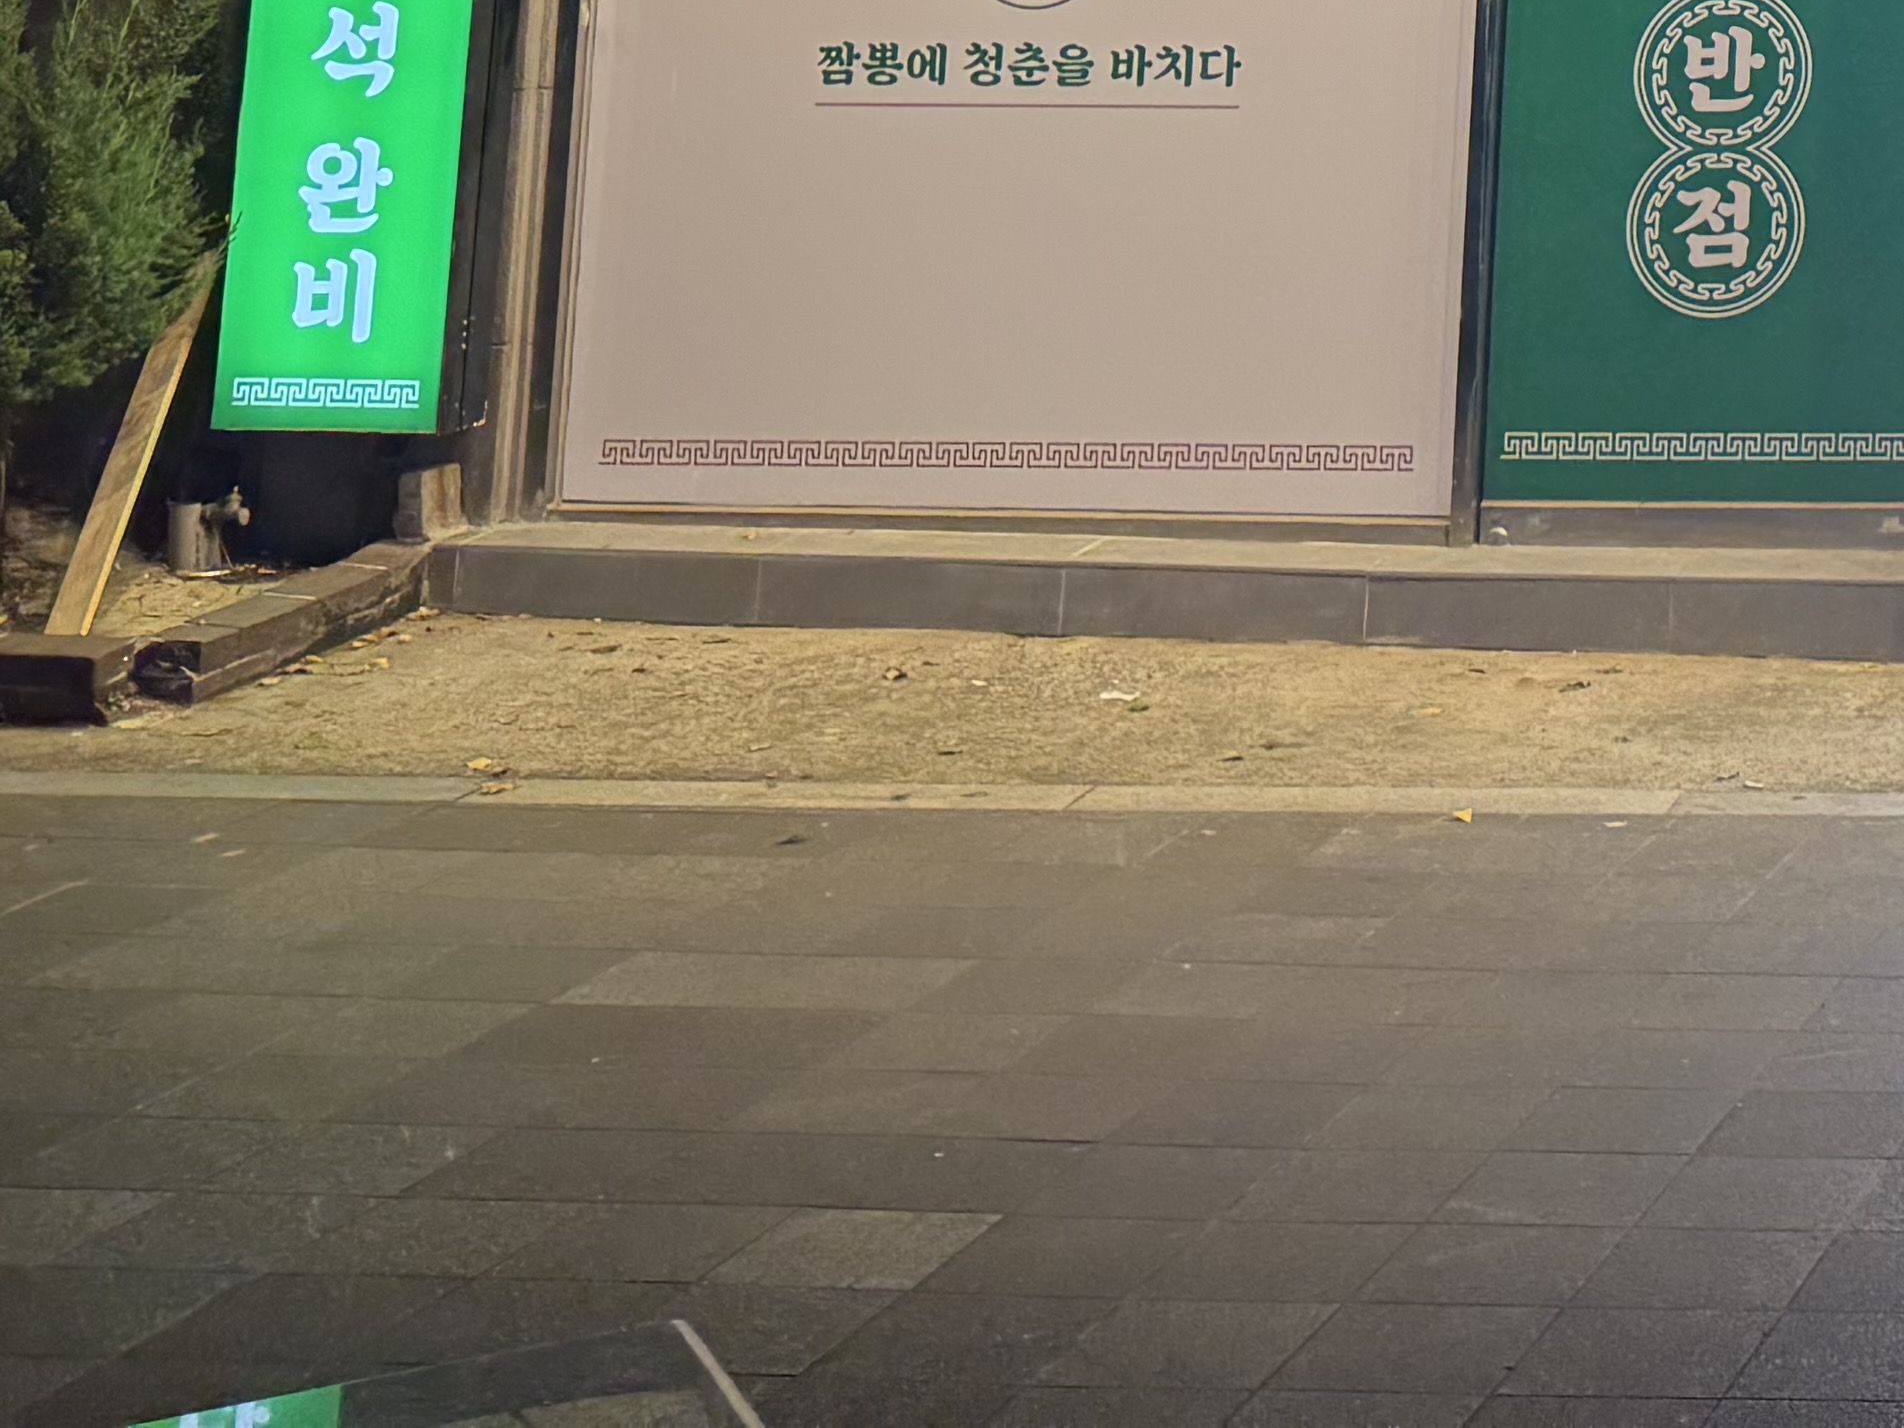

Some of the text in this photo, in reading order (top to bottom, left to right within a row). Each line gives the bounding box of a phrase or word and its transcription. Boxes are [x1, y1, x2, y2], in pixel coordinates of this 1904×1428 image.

[816, 40, 1243, 88] 짬뽕에 청춘을 바치다
[290, 135, 394, 344] 완비
